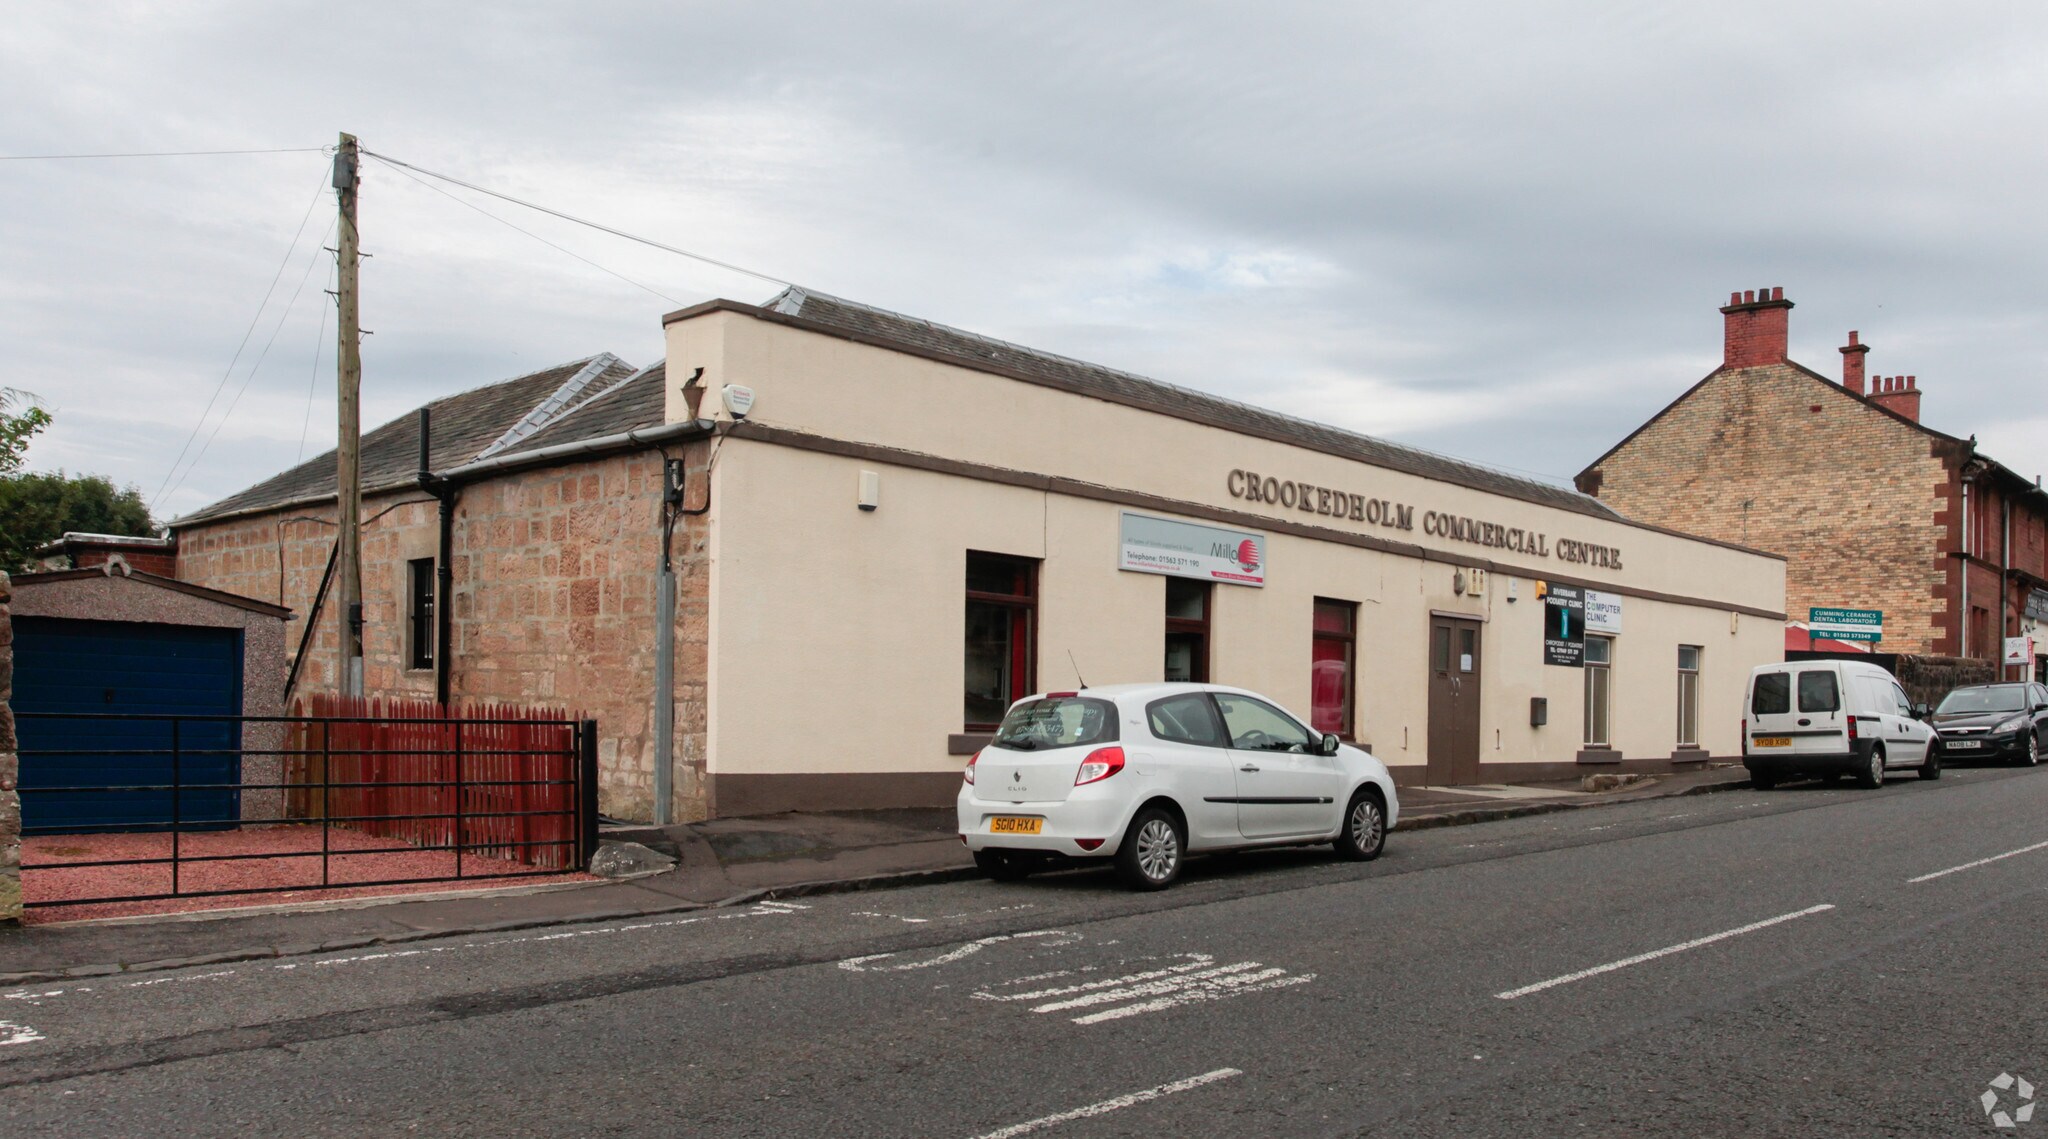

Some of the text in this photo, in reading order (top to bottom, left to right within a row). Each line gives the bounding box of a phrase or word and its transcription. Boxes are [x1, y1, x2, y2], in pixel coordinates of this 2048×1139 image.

[1227, 468, 1414, 531] CROOKEDHOLM
[1423, 510, 1550, 557] COMMERCIAL
[1127, 551, 1158, 562] Telephone:
[1586, 593, 1597, 601] THE
[1569, 600, 1583, 608] CLINIC
[1586, 601, 1621, 615] COMPUTER
[1586, 612, 1607, 623] CLINIC
[995, 818, 1036, 831] SG10 HXA
